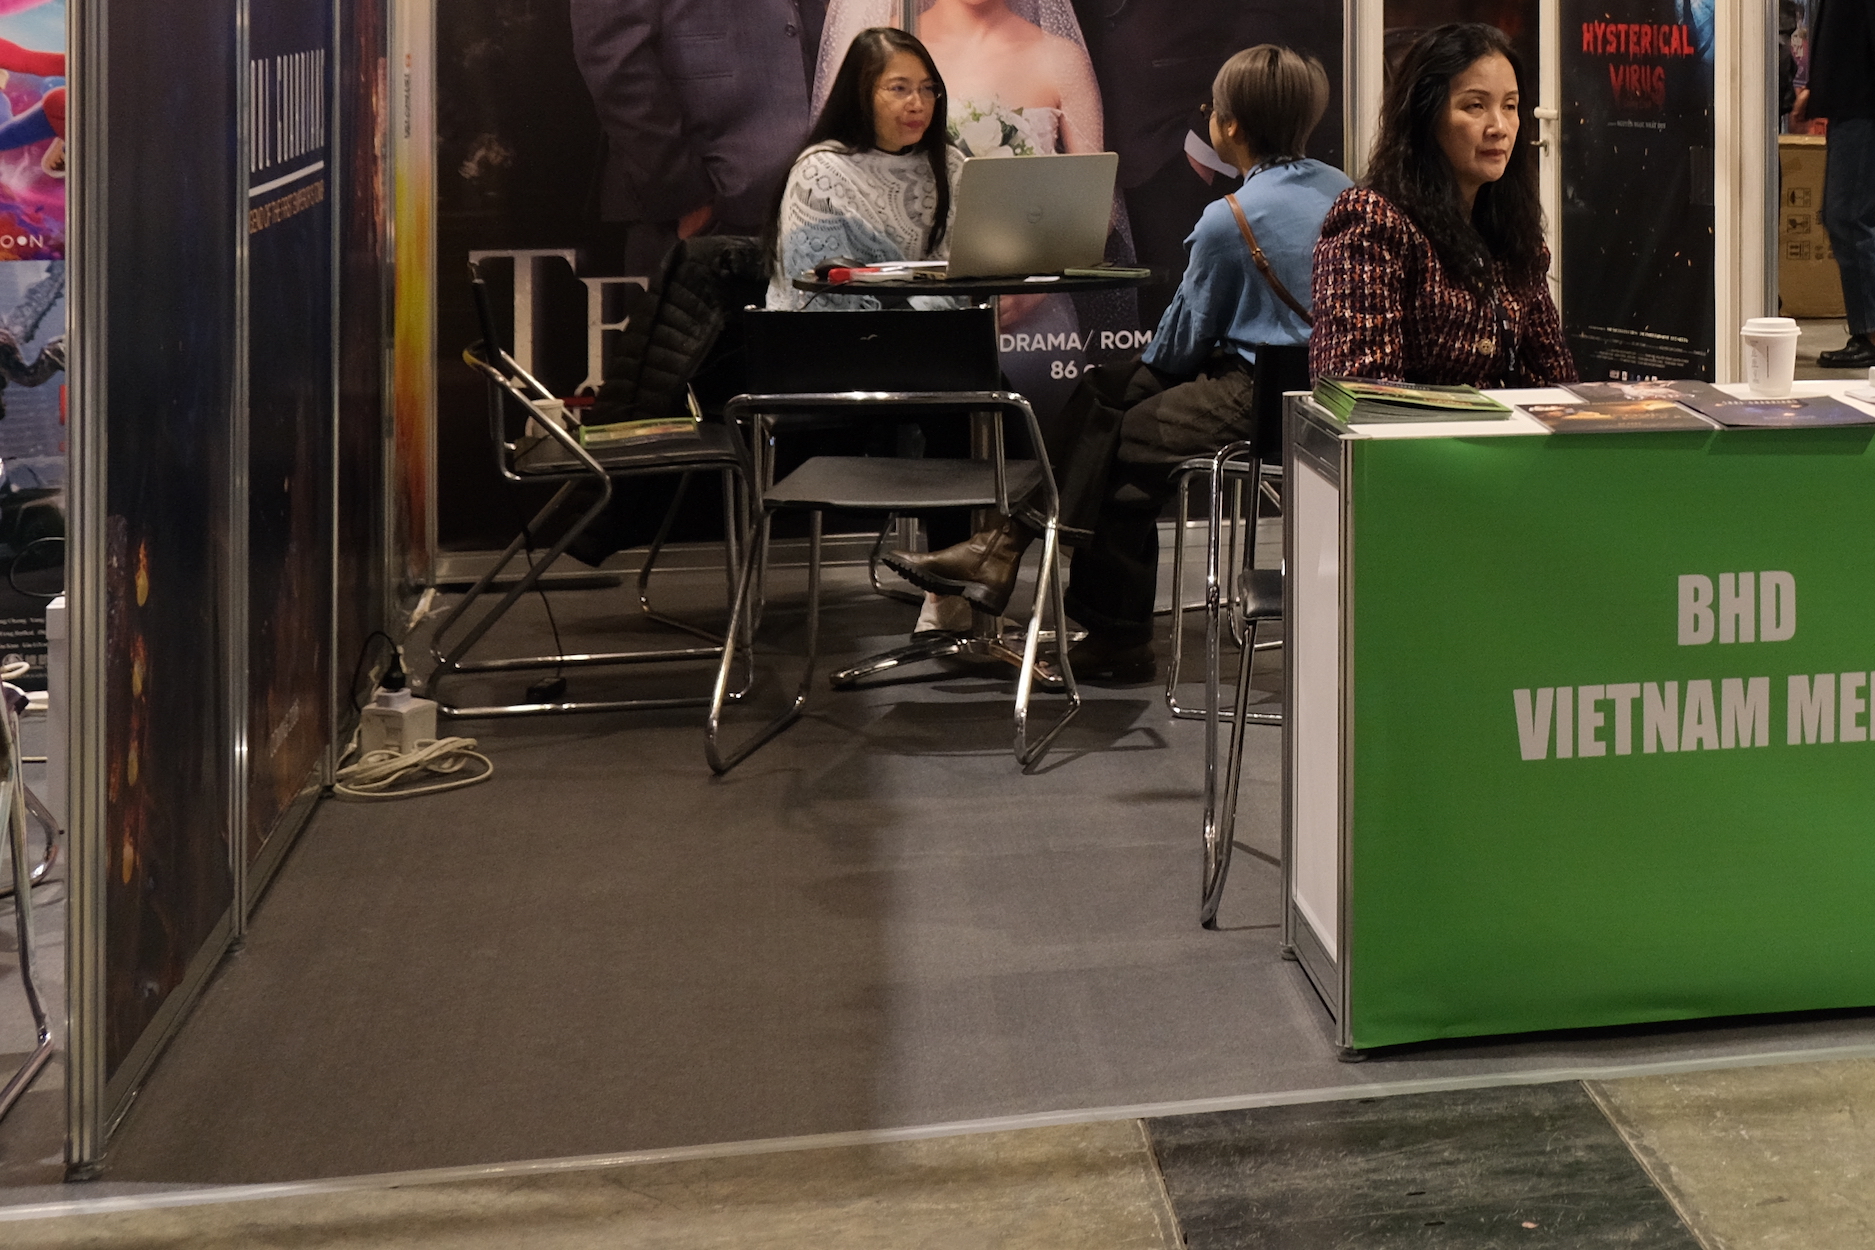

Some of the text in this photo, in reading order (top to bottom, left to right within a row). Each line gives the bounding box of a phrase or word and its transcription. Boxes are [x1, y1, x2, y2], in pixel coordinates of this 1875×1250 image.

[1582, 21, 1695, 57] HYSTERICAL
[1608, 63, 1667, 106] VIRUS
[1050, 360, 1079, 380] 86
[1677, 571, 1797, 645] BHD
[1513, 676, 1770, 761] VIETNAM
